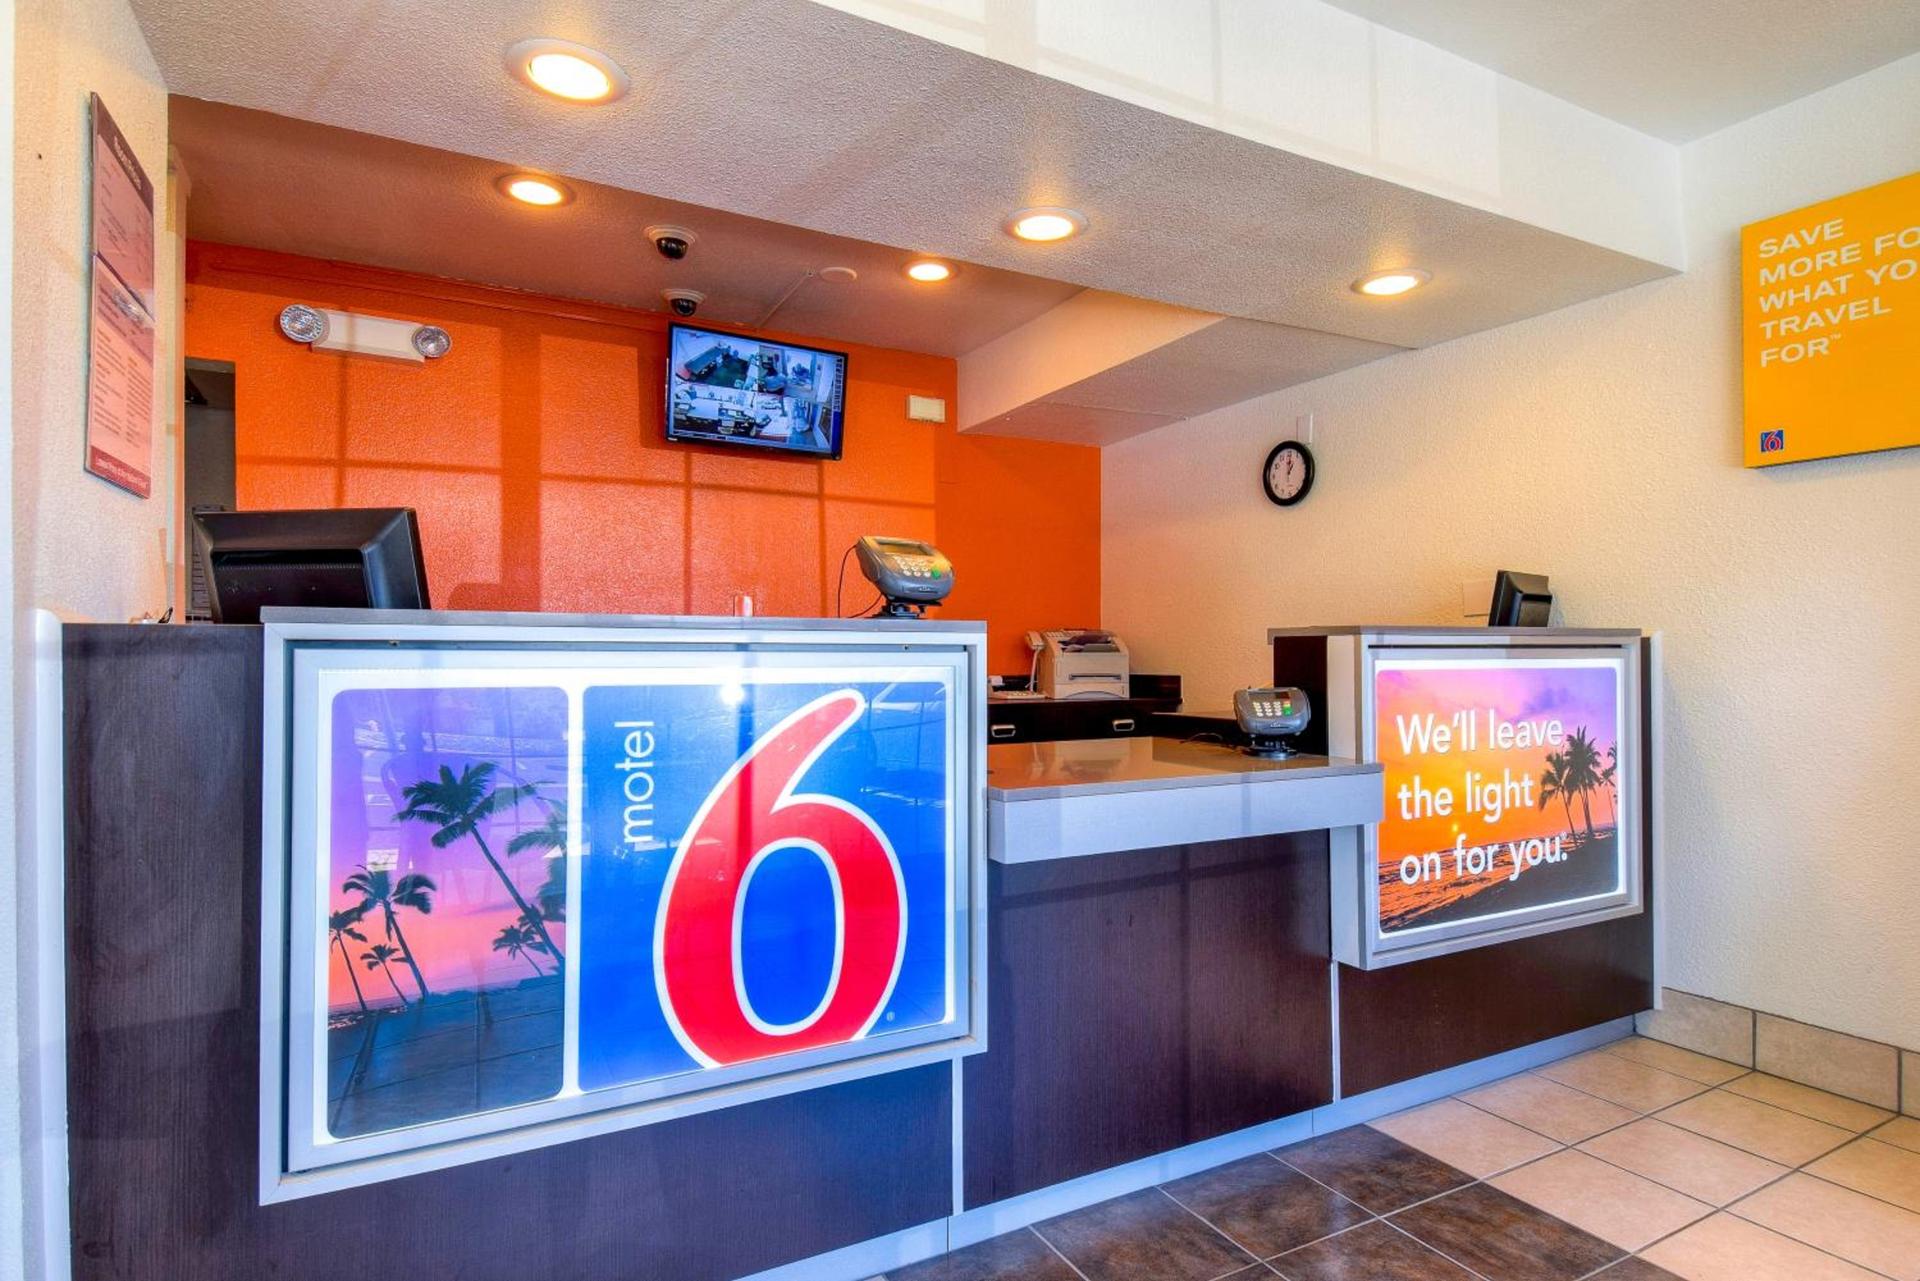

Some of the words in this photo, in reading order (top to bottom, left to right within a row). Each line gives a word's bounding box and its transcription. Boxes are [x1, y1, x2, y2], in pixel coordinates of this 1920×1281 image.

[1759, 218, 1844, 259] SAVE
[1759, 243, 1861, 286] MORE
[1759, 273, 1854, 313] WHAT
[1760, 296, 1892, 340] TRAVEL
[1396, 708, 1476, 755] We'll
[1489, 708, 1563, 750] leave
[1397, 775, 1453, 820] the
[1465, 768, 1534, 823] light
[614, 720, 655, 844] motel
[653, 688, 908, 1070] 6
[1399, 850, 1441, 885] on
[1453, 833, 1500, 877] for
